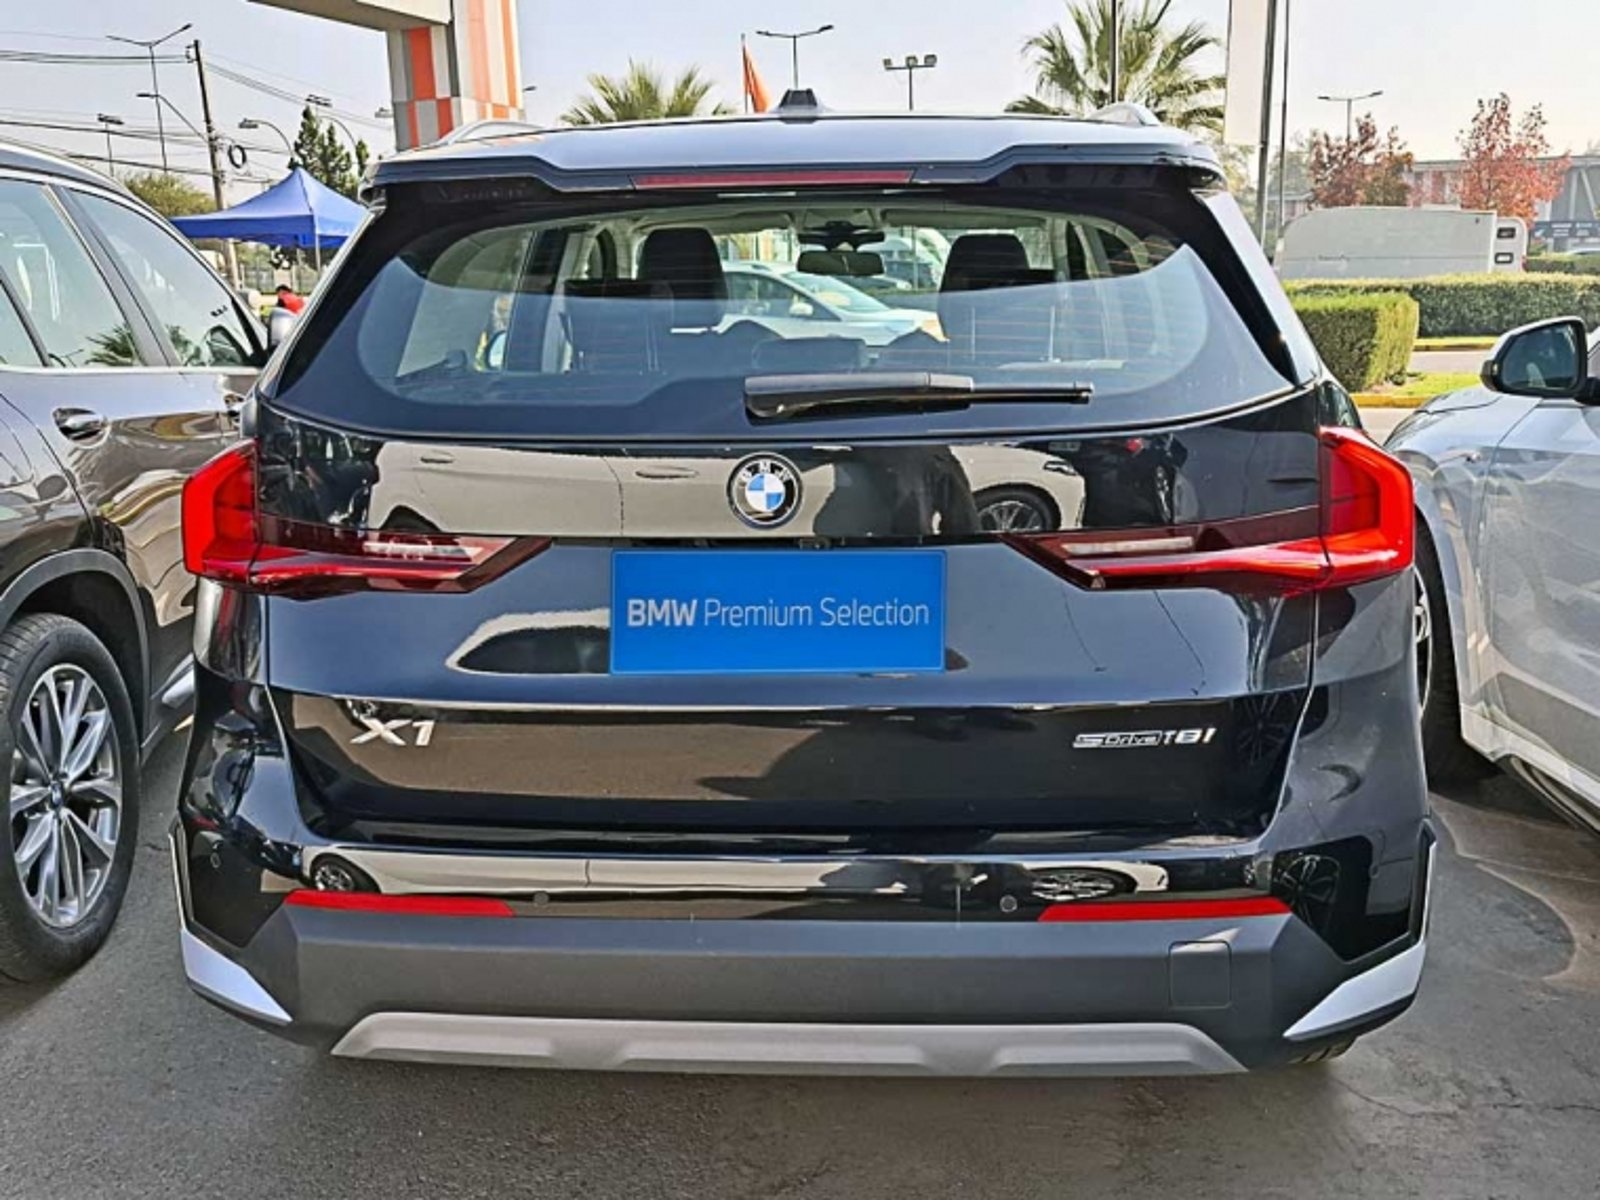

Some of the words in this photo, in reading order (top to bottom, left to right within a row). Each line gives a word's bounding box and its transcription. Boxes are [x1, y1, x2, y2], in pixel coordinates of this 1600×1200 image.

[627, 598, 698, 627] BMW
[704, 598, 812, 627] Premium
[820, 597, 930, 627] Selection
[349, 716, 435, 746] X1
